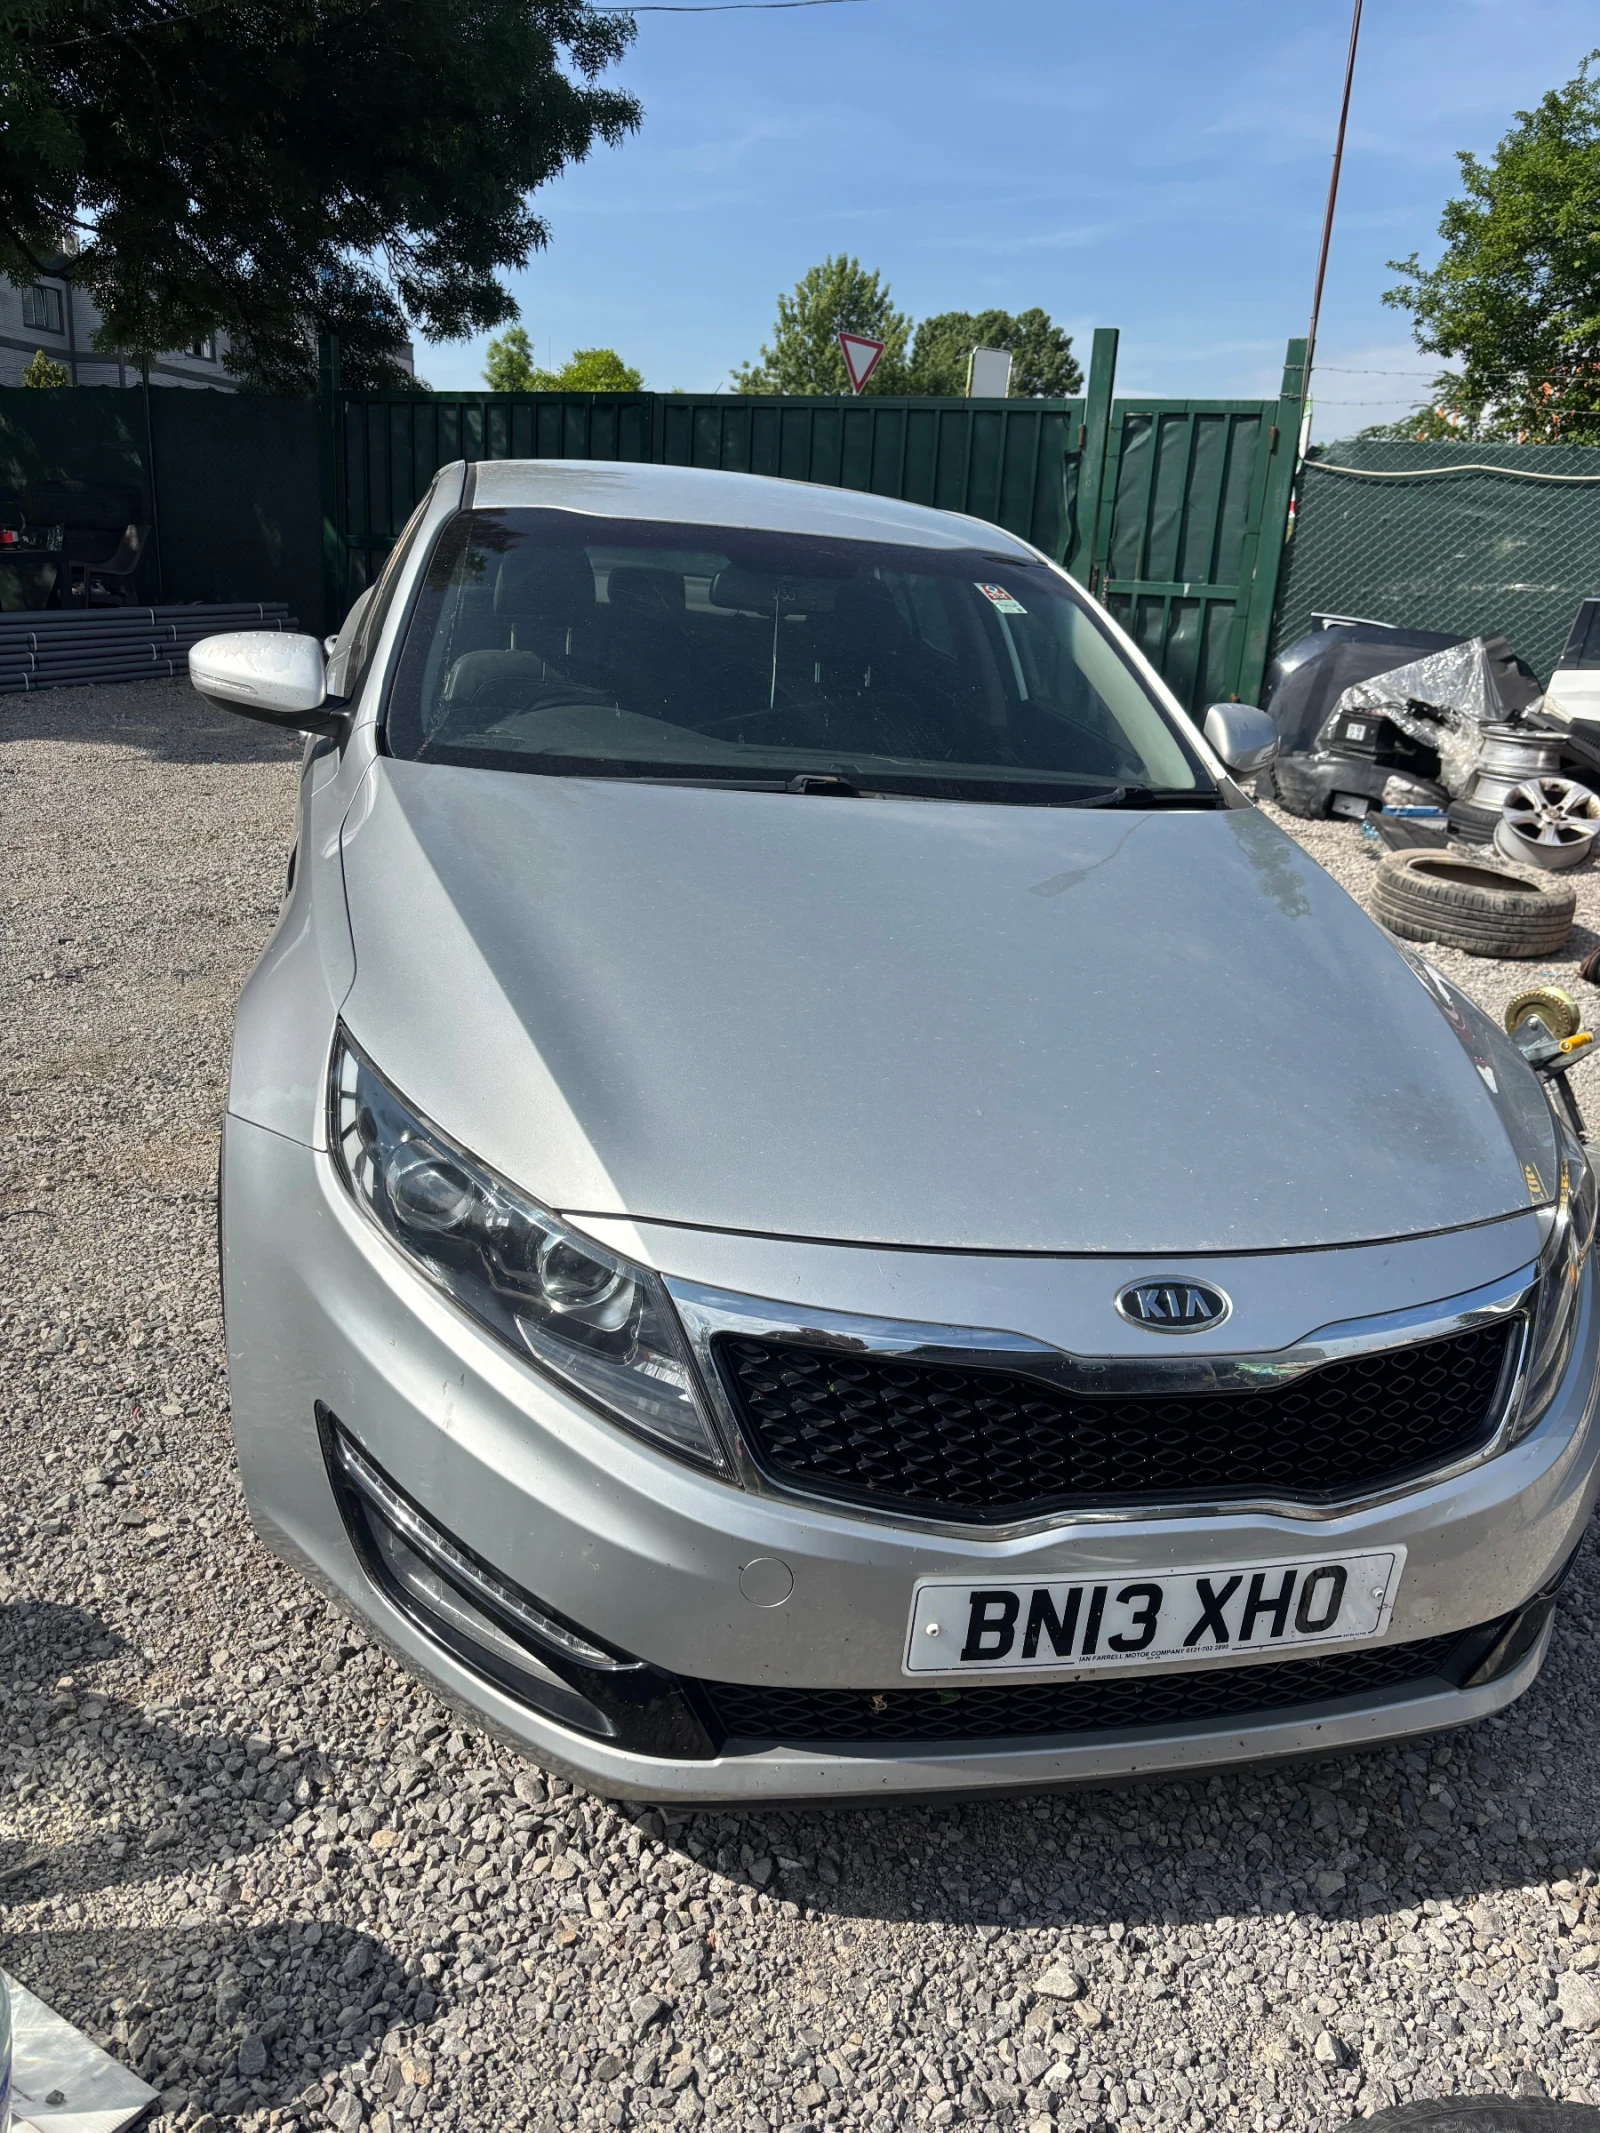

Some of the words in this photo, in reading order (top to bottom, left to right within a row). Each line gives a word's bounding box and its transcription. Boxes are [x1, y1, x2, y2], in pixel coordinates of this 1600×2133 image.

[1137, 1289, 1213, 1318] KIA
[960, 1584, 1163, 1661] BN13
[1183, 1565, 1348, 1647] XHO
[1150, 1648, 1185, 1656] COMPANY
